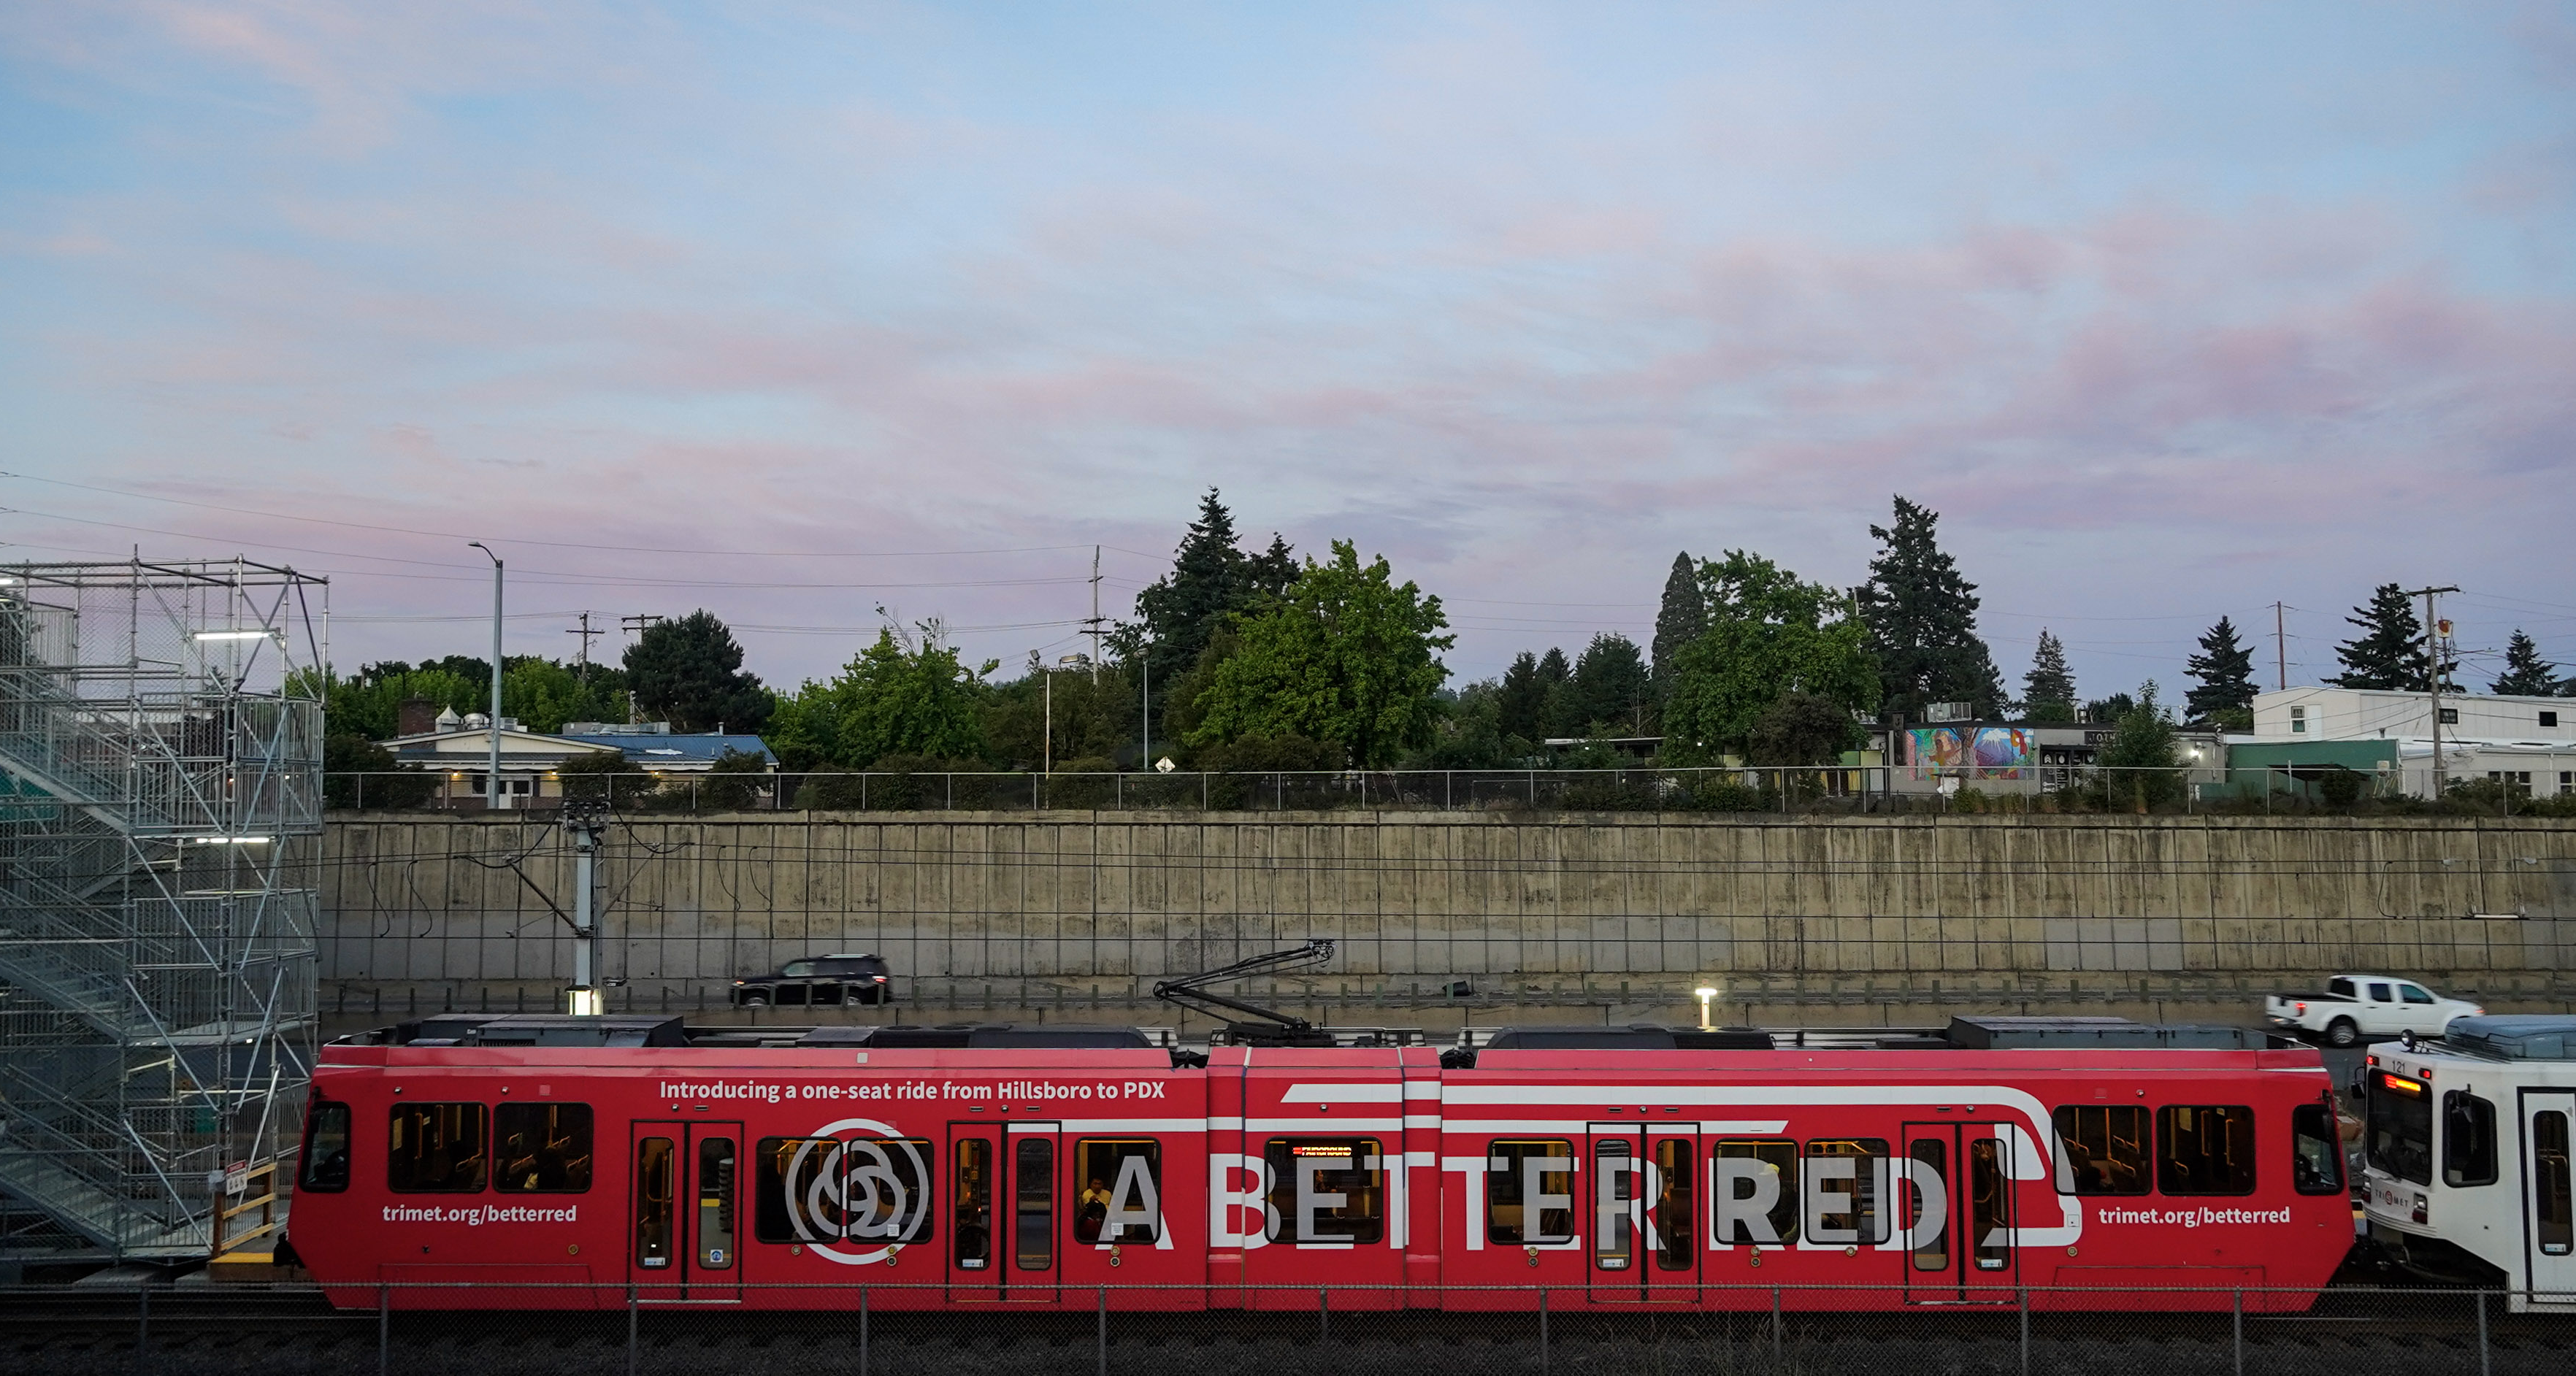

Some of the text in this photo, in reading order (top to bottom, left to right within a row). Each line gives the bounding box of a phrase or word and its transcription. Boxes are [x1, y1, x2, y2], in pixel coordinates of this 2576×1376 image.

[2392, 1060, 2406, 1074] 121
[661, 1080, 1165, 1103] Introducing a one-seat ride from Hillsboro to PDX
[1095, 1152, 1947, 1251] A BETTER RED
[383, 1204, 576, 1226] trimet.org/betterred
[2098, 1206, 2290, 1228] trimet.org/betterred
